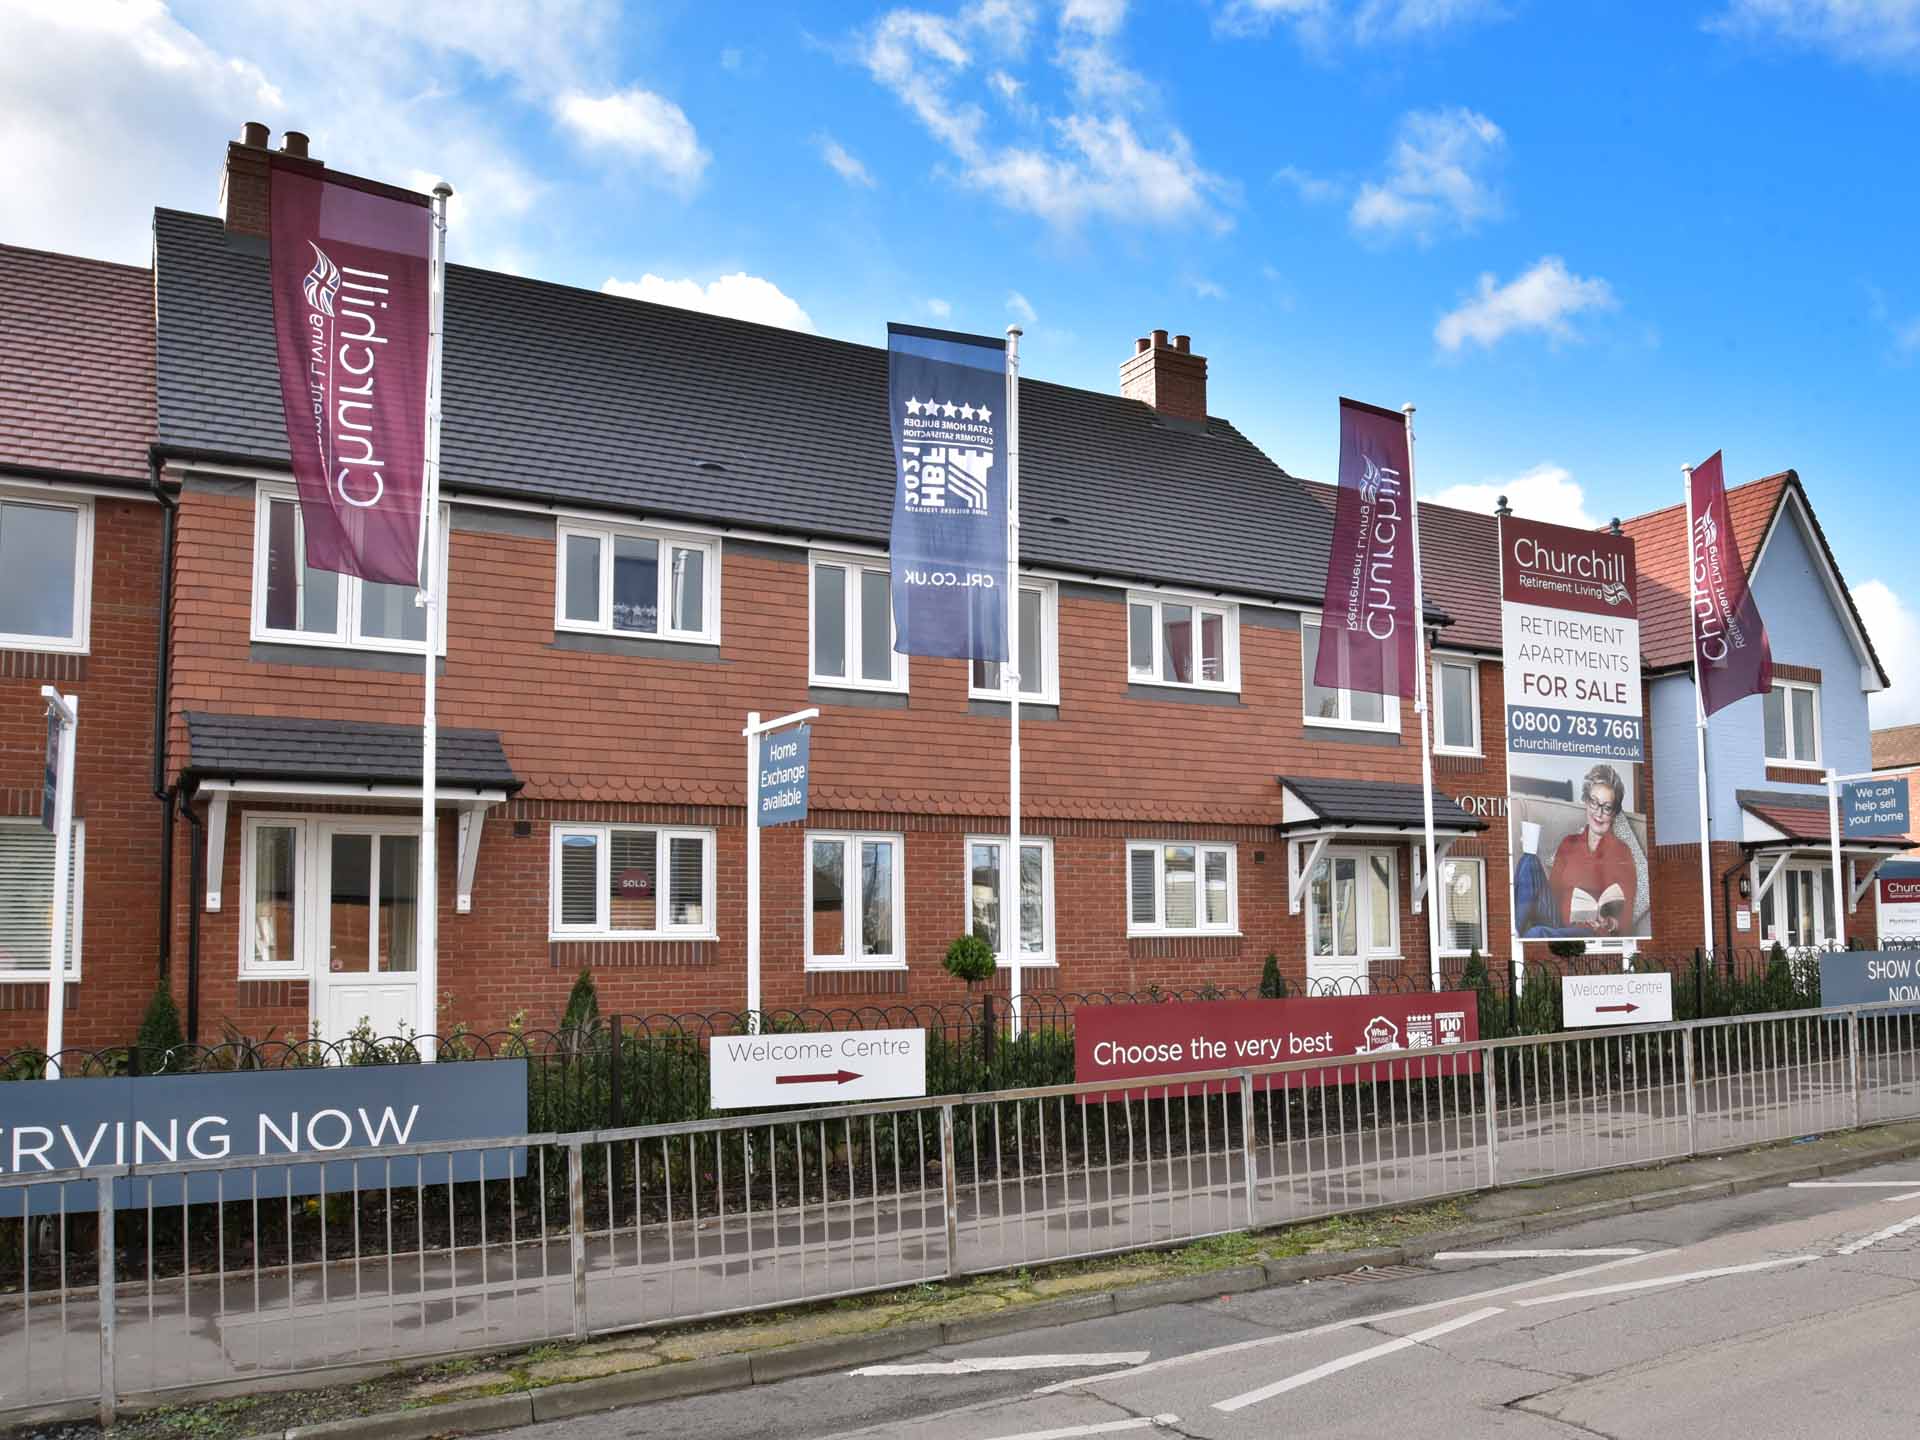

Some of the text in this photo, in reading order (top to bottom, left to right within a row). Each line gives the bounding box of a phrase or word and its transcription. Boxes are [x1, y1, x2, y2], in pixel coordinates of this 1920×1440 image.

[1514, 538, 1626, 583] Churchill
[1520, 574, 1602, 600] Retirement Living
[1709, 545, 1747, 649] Retirement Living
[1520, 615, 1625, 646] RETIREMENT
[1518, 643, 1630, 673] APARTMENTS
[1523, 673, 1628, 704] FOR SALE
[1512, 710, 1640, 740] 0800 783 7661
[770, 742, 797, 762] Home
[1513, 736, 1640, 757] churchillretirement.co.uk
[761, 765, 805, 788] Exchange
[762, 787, 802, 812] available
[1855, 787, 1895, 798] We can
[1454, 794, 1508, 817] ORTI
[1855, 798, 1896, 812] help sell
[1849, 812, 1904, 827] your home
[623, 880, 647, 888] SOLD
[1867, 960, 1911, 980] SHOW
[1570, 980, 1663, 997] Welcome Centre
[1370, 1028, 1388, 1037] What
[1440, 1018, 1461, 1032] 100
[727, 1037, 911, 1062] Welcome Centre
[1093, 1031, 1333, 1066] Choose the very best
[0, 1104, 420, 1172] RVING NOW
